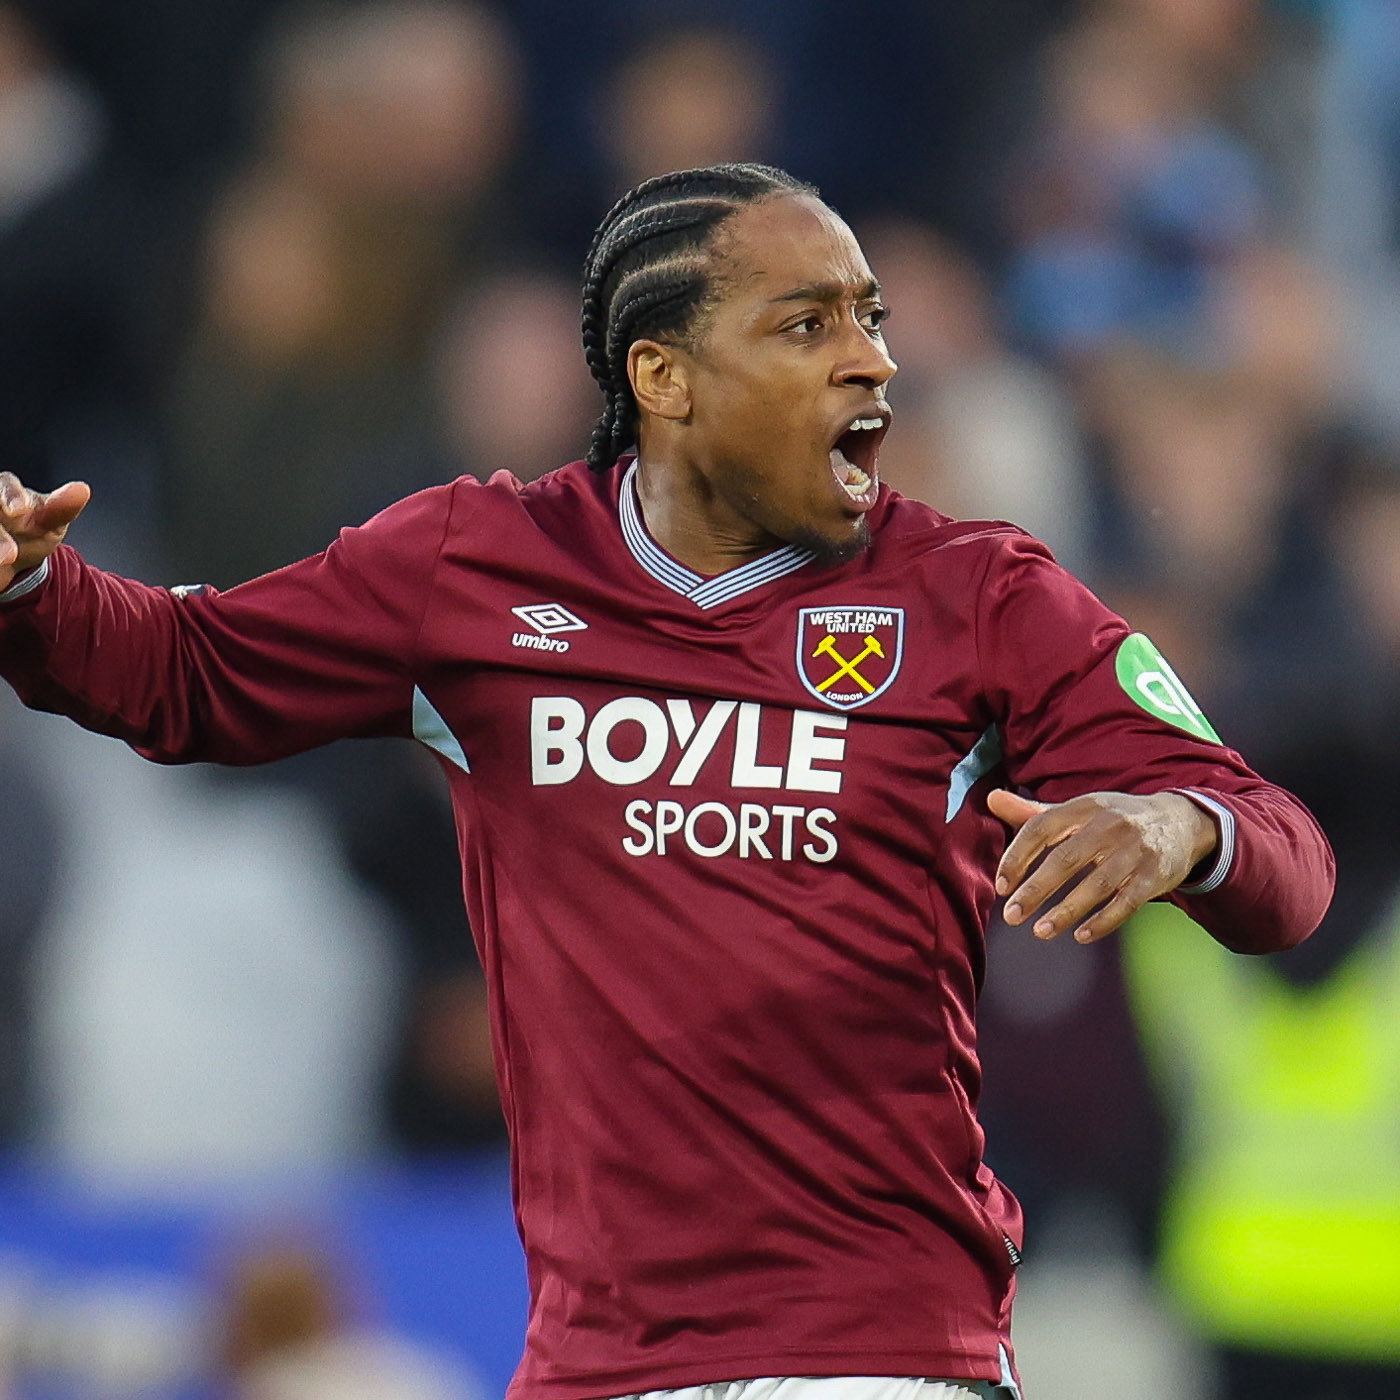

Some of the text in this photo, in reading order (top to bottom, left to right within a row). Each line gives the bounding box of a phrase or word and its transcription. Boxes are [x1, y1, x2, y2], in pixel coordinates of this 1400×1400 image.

[810, 612, 893, 626] WEST HAM
[826, 623, 875, 633] UNITED
[512, 633, 569, 653] umbro
[826, 691, 863, 701] LONDON
[531, 697, 848, 794] BOYLE
[623, 800, 838, 862] SPORTS
